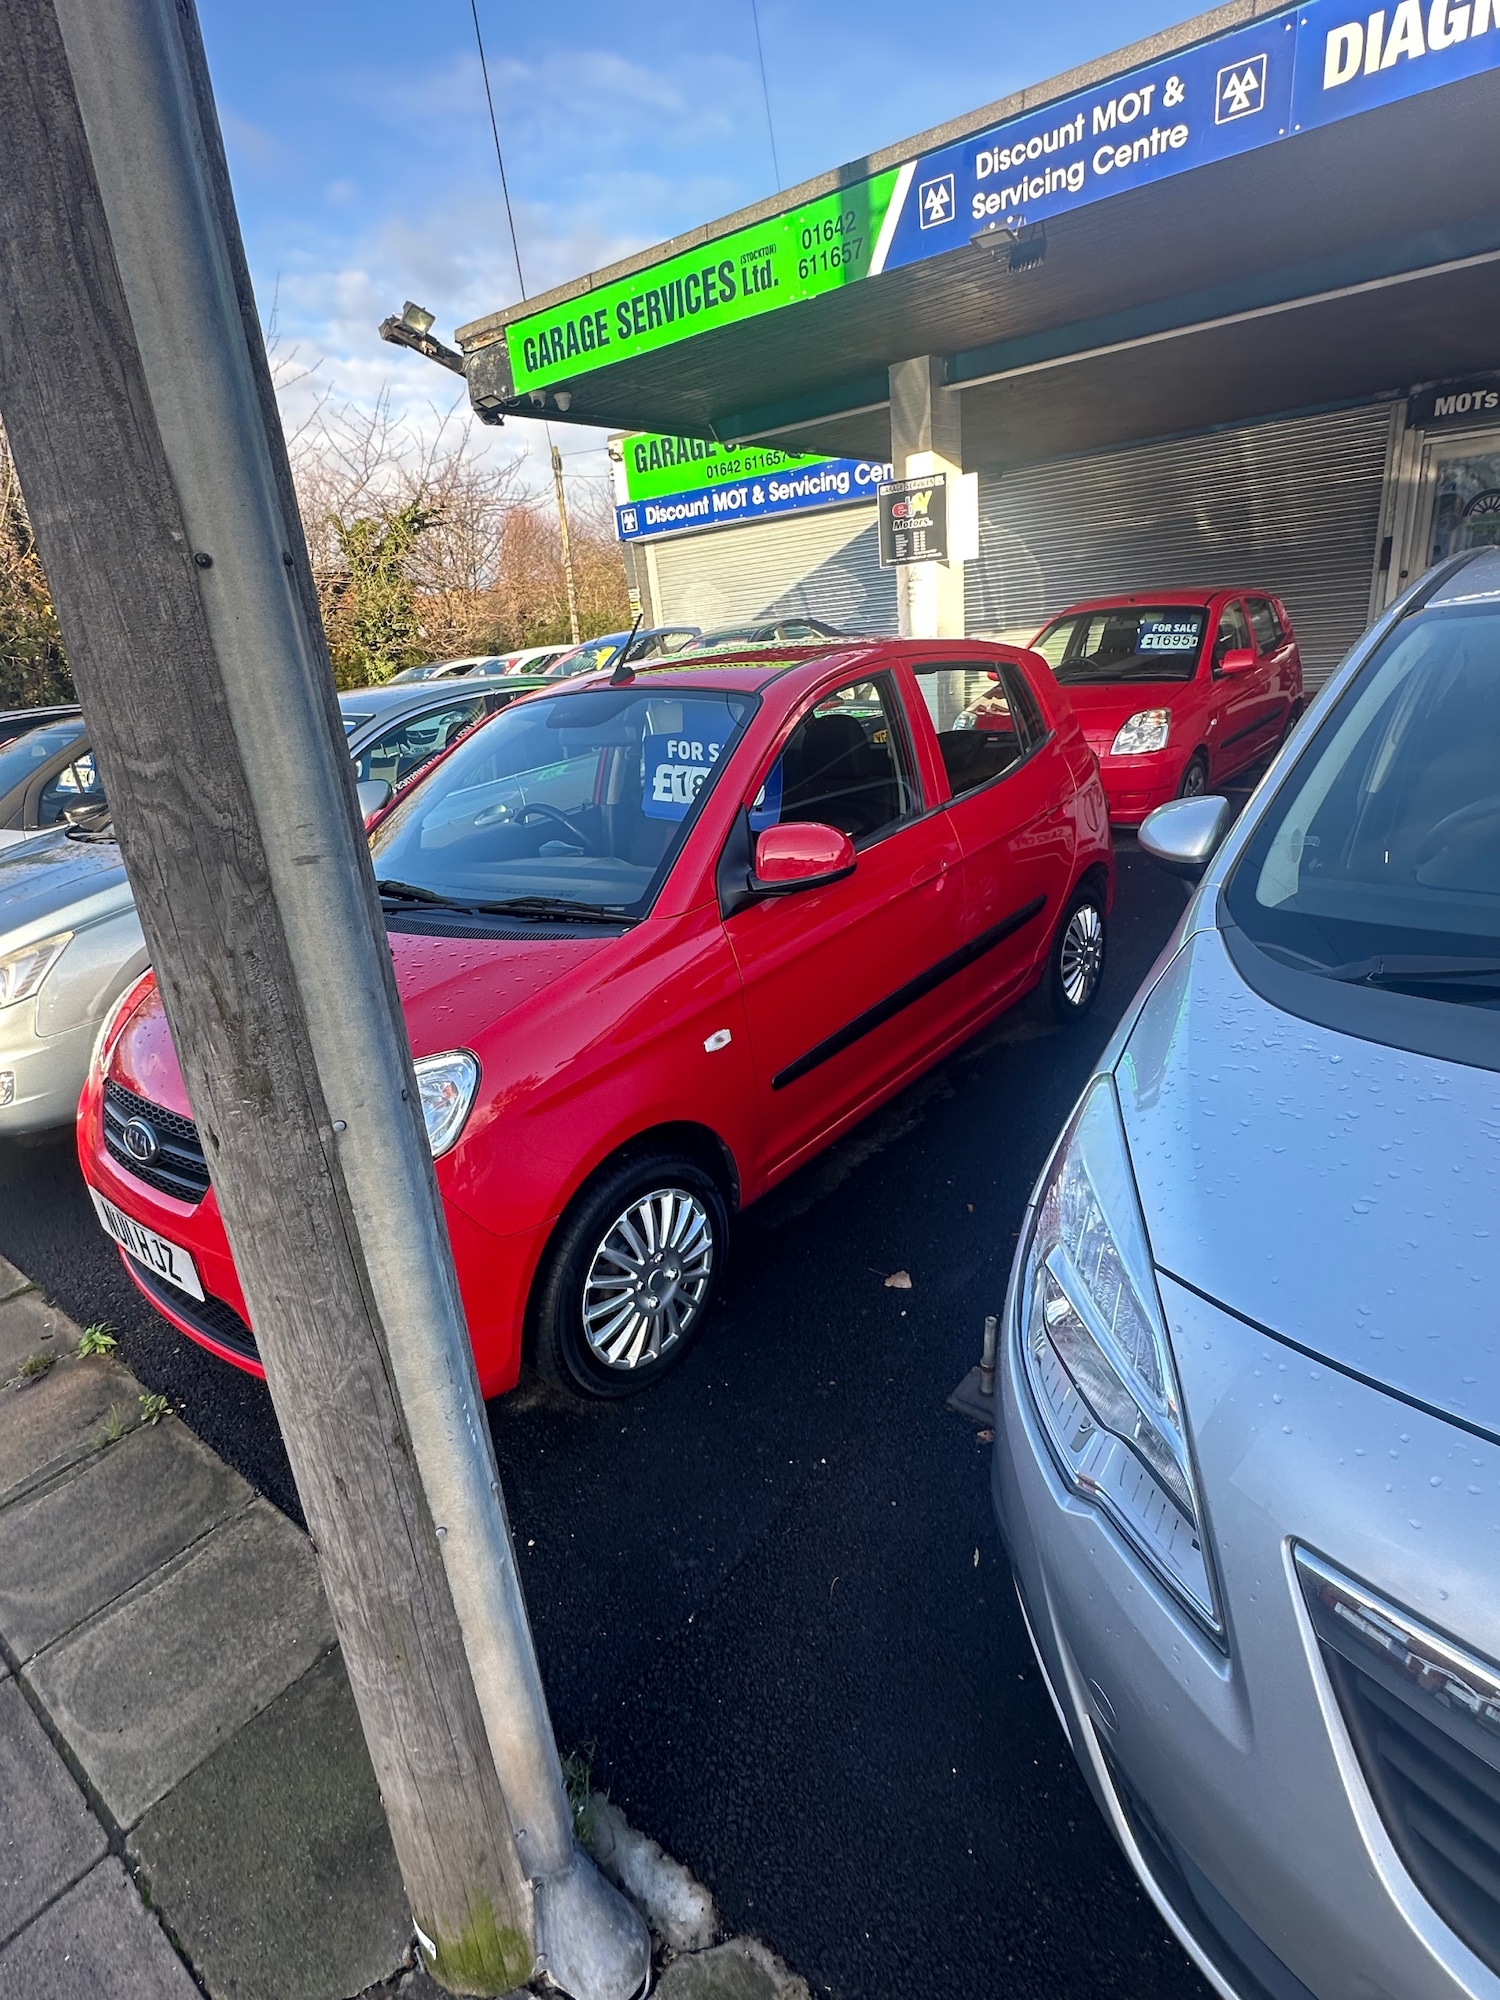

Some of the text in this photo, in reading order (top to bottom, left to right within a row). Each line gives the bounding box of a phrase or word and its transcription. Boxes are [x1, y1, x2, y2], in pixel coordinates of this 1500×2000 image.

[976, 75, 1186, 181] Discount MOT &
[972, 122, 1189, 220] Servicing Centre
[802, 211, 856, 250] 01642
[740, 243, 777, 266] (STOCKTON)
[799, 237, 863, 280] 611657
[523, 258, 779, 374] GARAGE SERVICES Ltd.
[1434, 390, 1499, 417] MOTs
[706, 460, 741, 479] 01642
[744, 451, 787, 471] 611657
[645, 463, 894, 525] Discount MOT & Servicing Cen
[1152, 623, 1198, 633] FOR SALE
[667, 740, 704, 761] FOR
